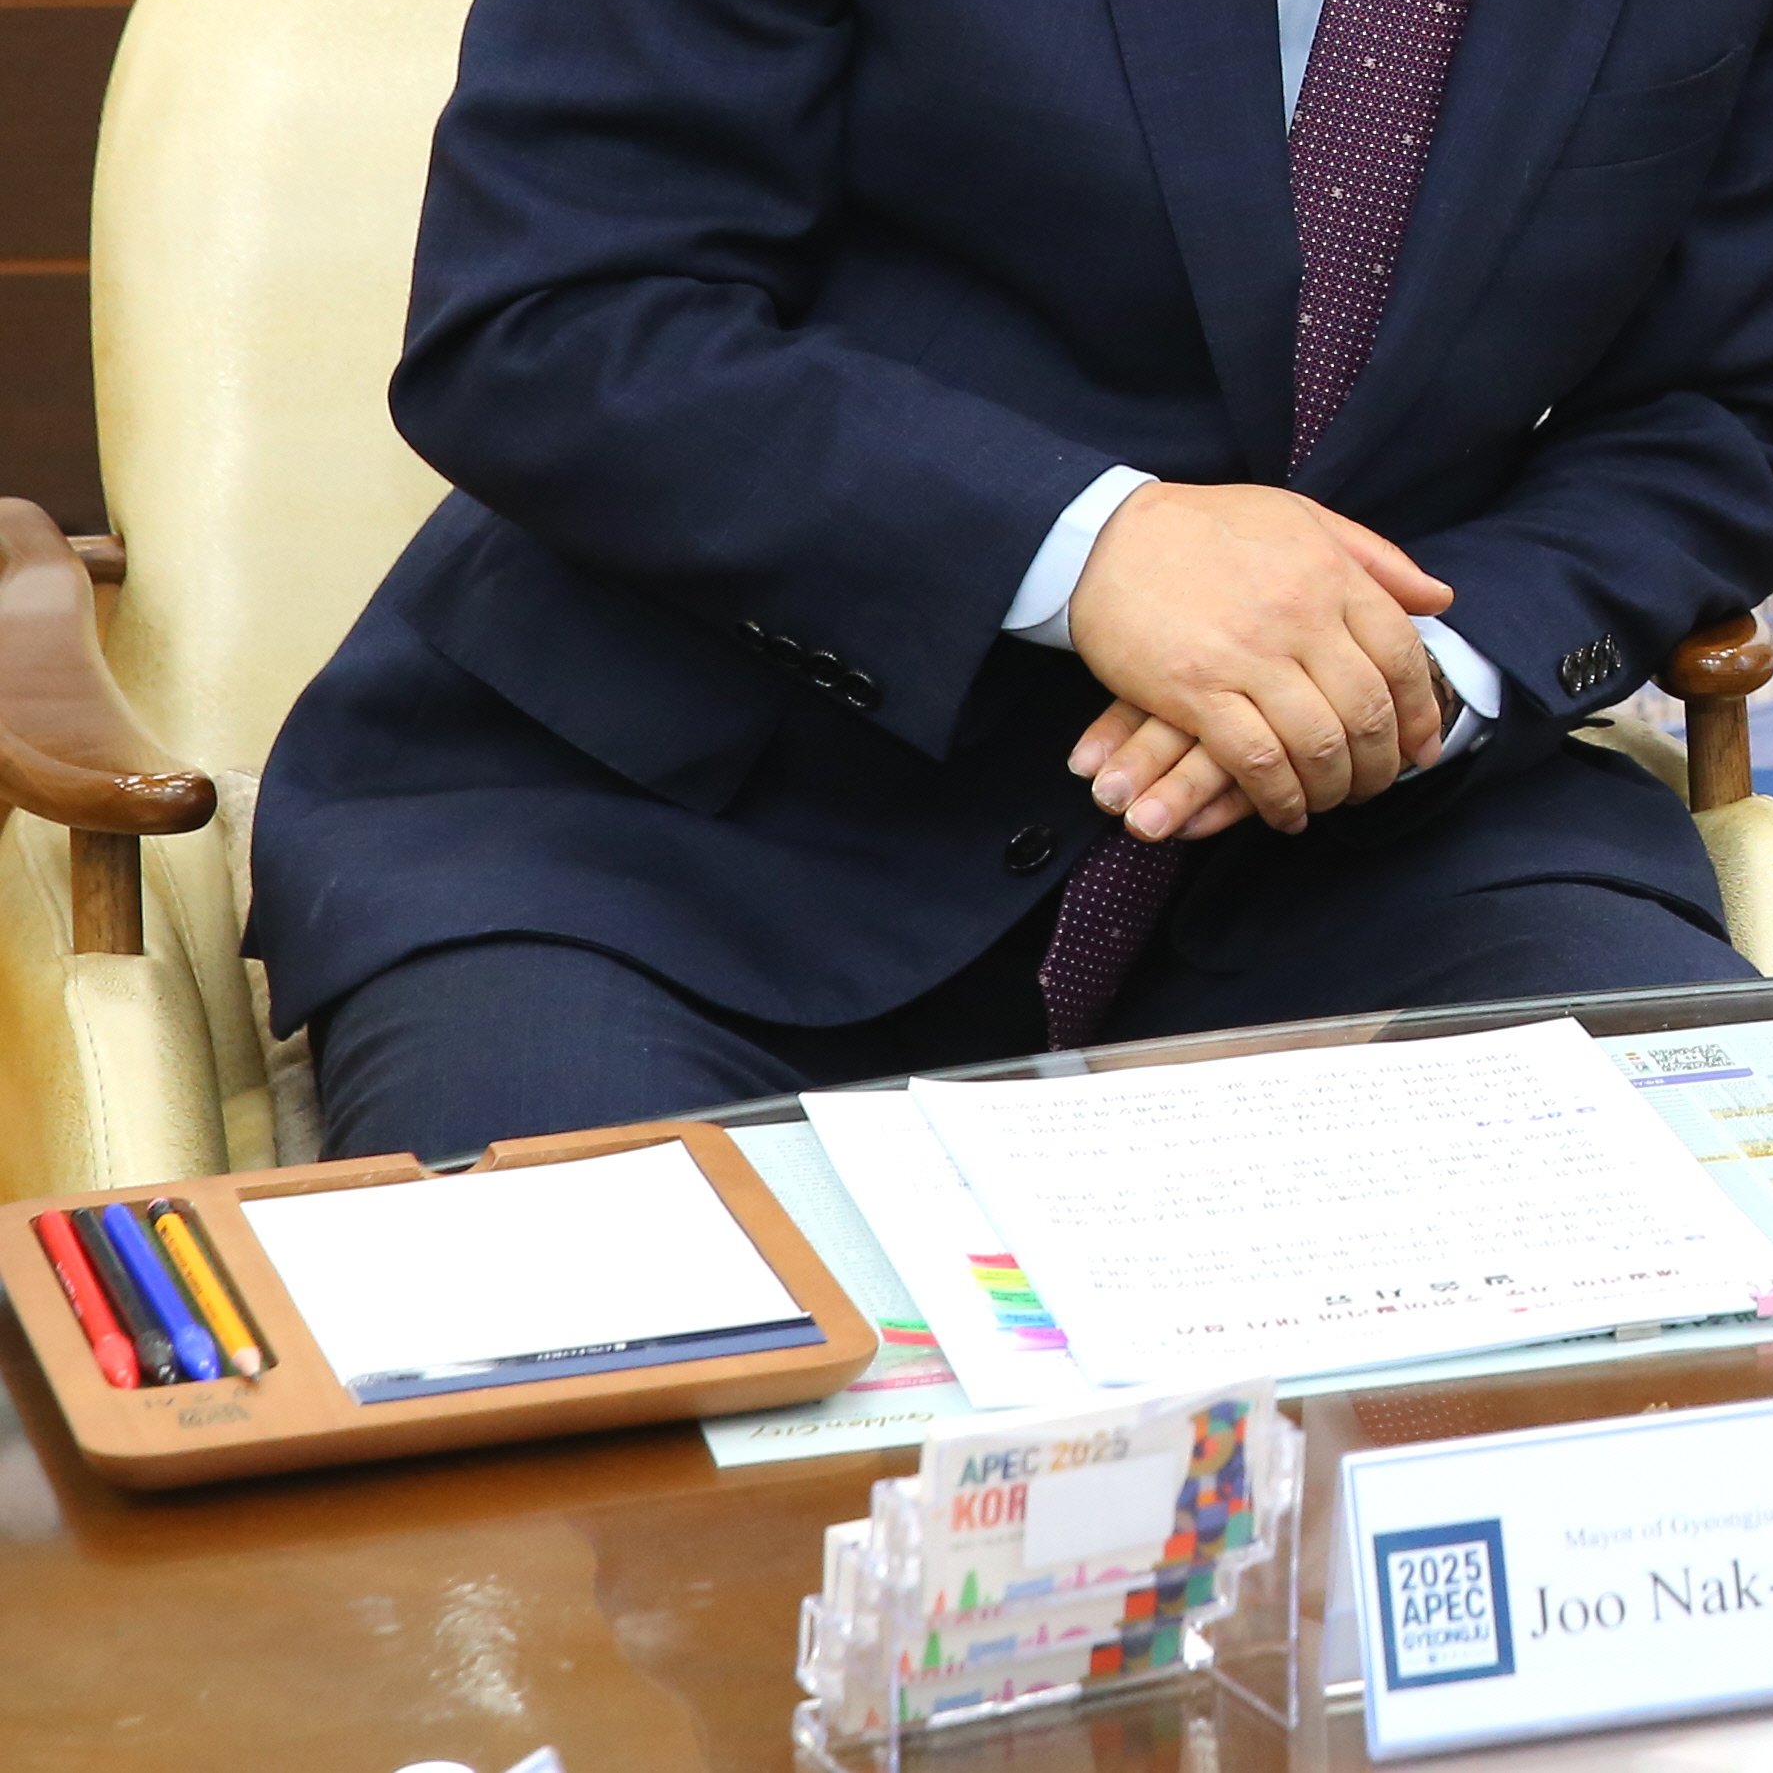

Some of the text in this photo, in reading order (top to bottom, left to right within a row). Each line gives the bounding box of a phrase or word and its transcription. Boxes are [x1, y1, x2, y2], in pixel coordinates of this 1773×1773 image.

[959, 1428, 1130, 1486] APEC 2025
[1564, 1527, 1634, 1550] Mayor
[1640, 1517, 1664, 1539] of
[1398, 1550, 1482, 1591] 2025
[1403, 1587, 1486, 1628] APEC
[1531, 1584, 1627, 1640] Joo
